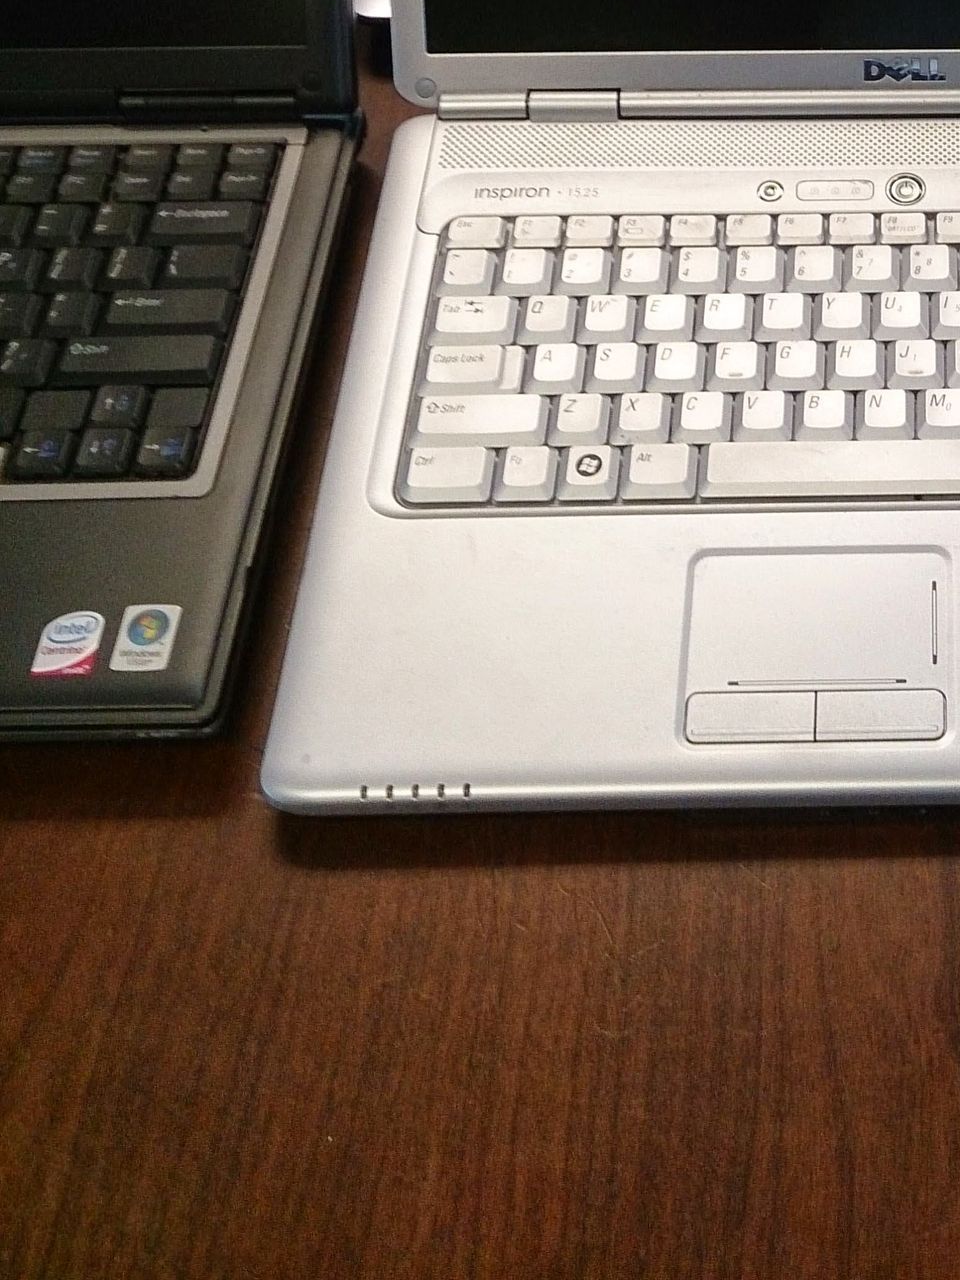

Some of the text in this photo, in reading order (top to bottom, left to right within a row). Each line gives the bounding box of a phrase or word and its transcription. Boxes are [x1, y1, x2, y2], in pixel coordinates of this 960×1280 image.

[474, 186, 599, 201] inspiron 1525
[943, 215, 953, 223] F9
[740, 268, 747, 277] 5
[798, 267, 805, 276] 6
[856, 266, 863, 276] 7
[914, 265, 922, 275] 8
[531, 301, 544, 314] Q
[650, 299, 662, 312] E
[709, 299, 720, 311] R
[768, 298, 778, 310] T
[826, 297, 836, 310] Y
[884, 296, 896, 309] U
[433, 353, 485, 363] Caps Lock
[540, 350, 552, 362] A
[600, 348, 612, 361] S
[661, 348, 672, 360] D
[720, 348, 731, 360] F
[780, 346, 792, 359] G
[840, 346, 852, 358] H
[899, 345, 909, 358] J
[563, 399, 577, 412] Z
[625, 398, 639, 412] X
[686, 397, 698, 410] C
[747, 397, 758, 410] V
[809, 396, 820, 409] B
[869, 395, 883, 408] N
[930, 394, 946, 407] M
